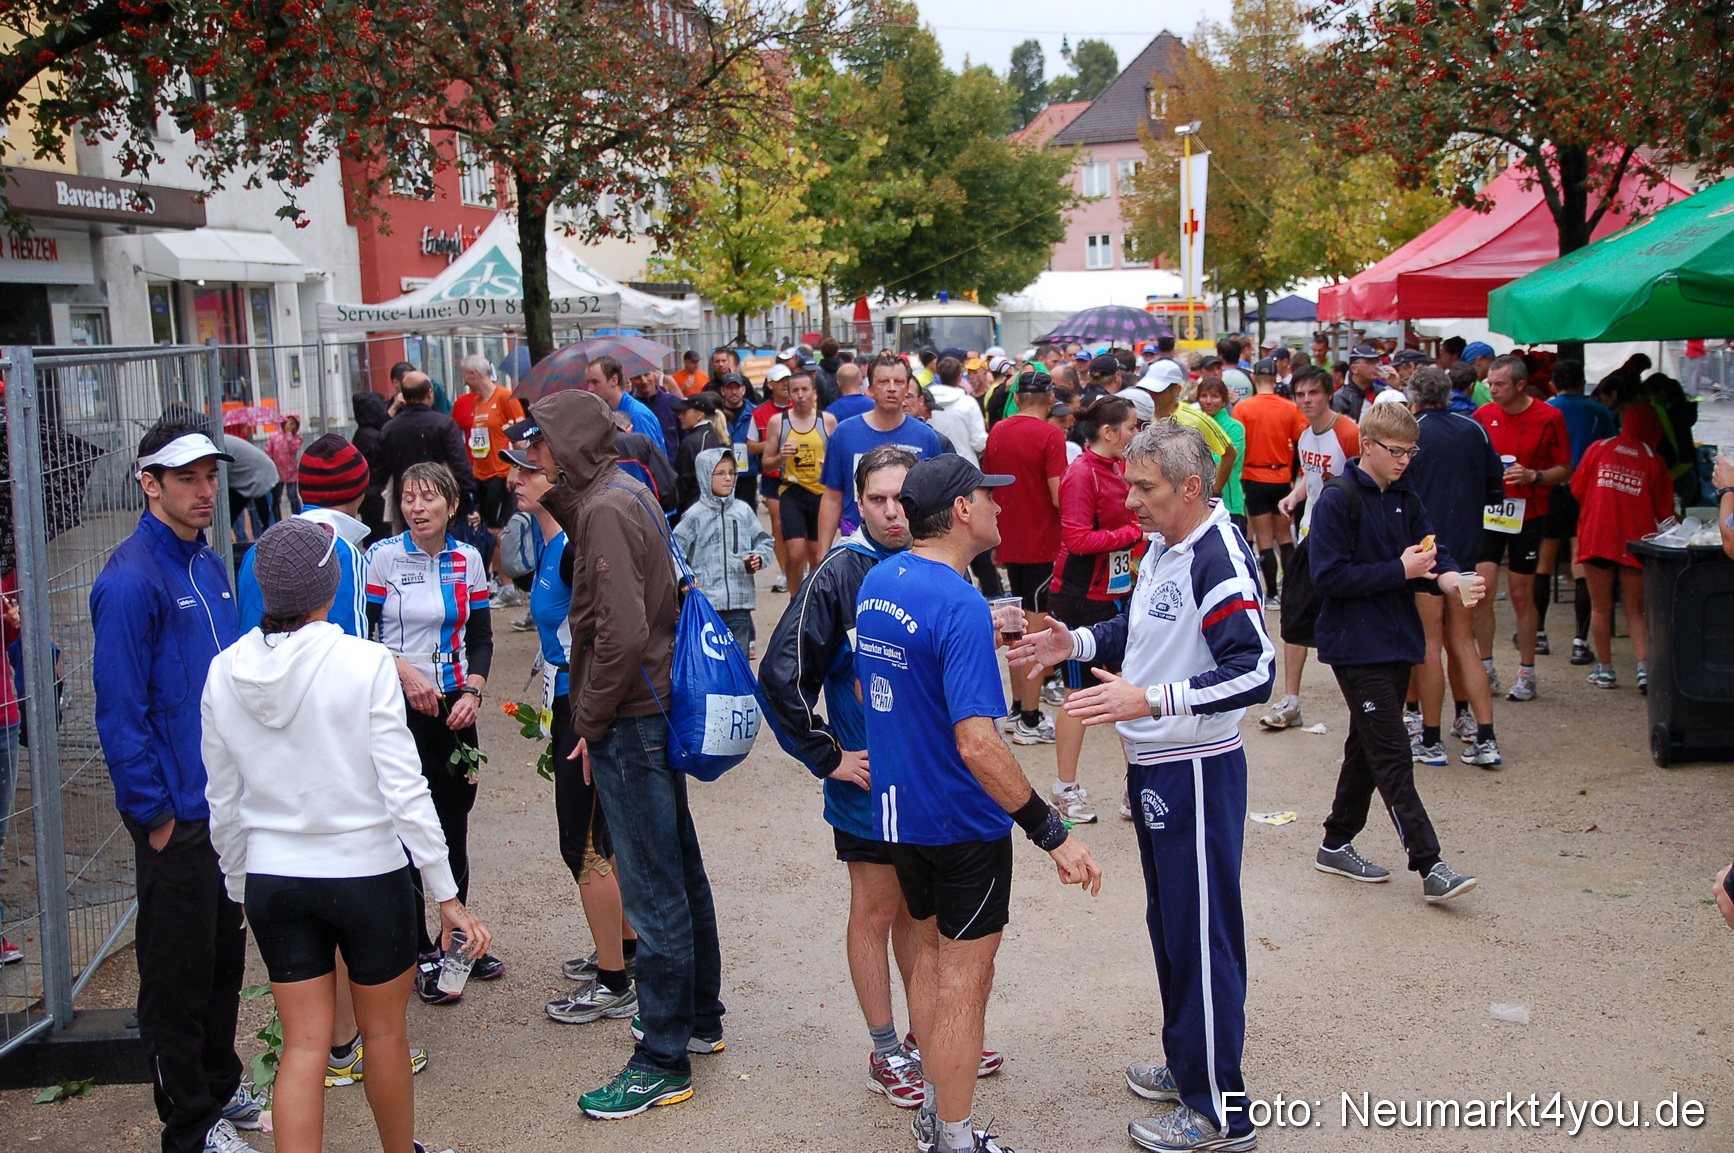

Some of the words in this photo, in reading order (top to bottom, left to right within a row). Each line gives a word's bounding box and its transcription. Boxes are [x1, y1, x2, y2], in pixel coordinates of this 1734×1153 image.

[10, 237, 58, 261] HERZEN
[579, 296, 600, 313] 52
[729, 707, 759, 740] RE
